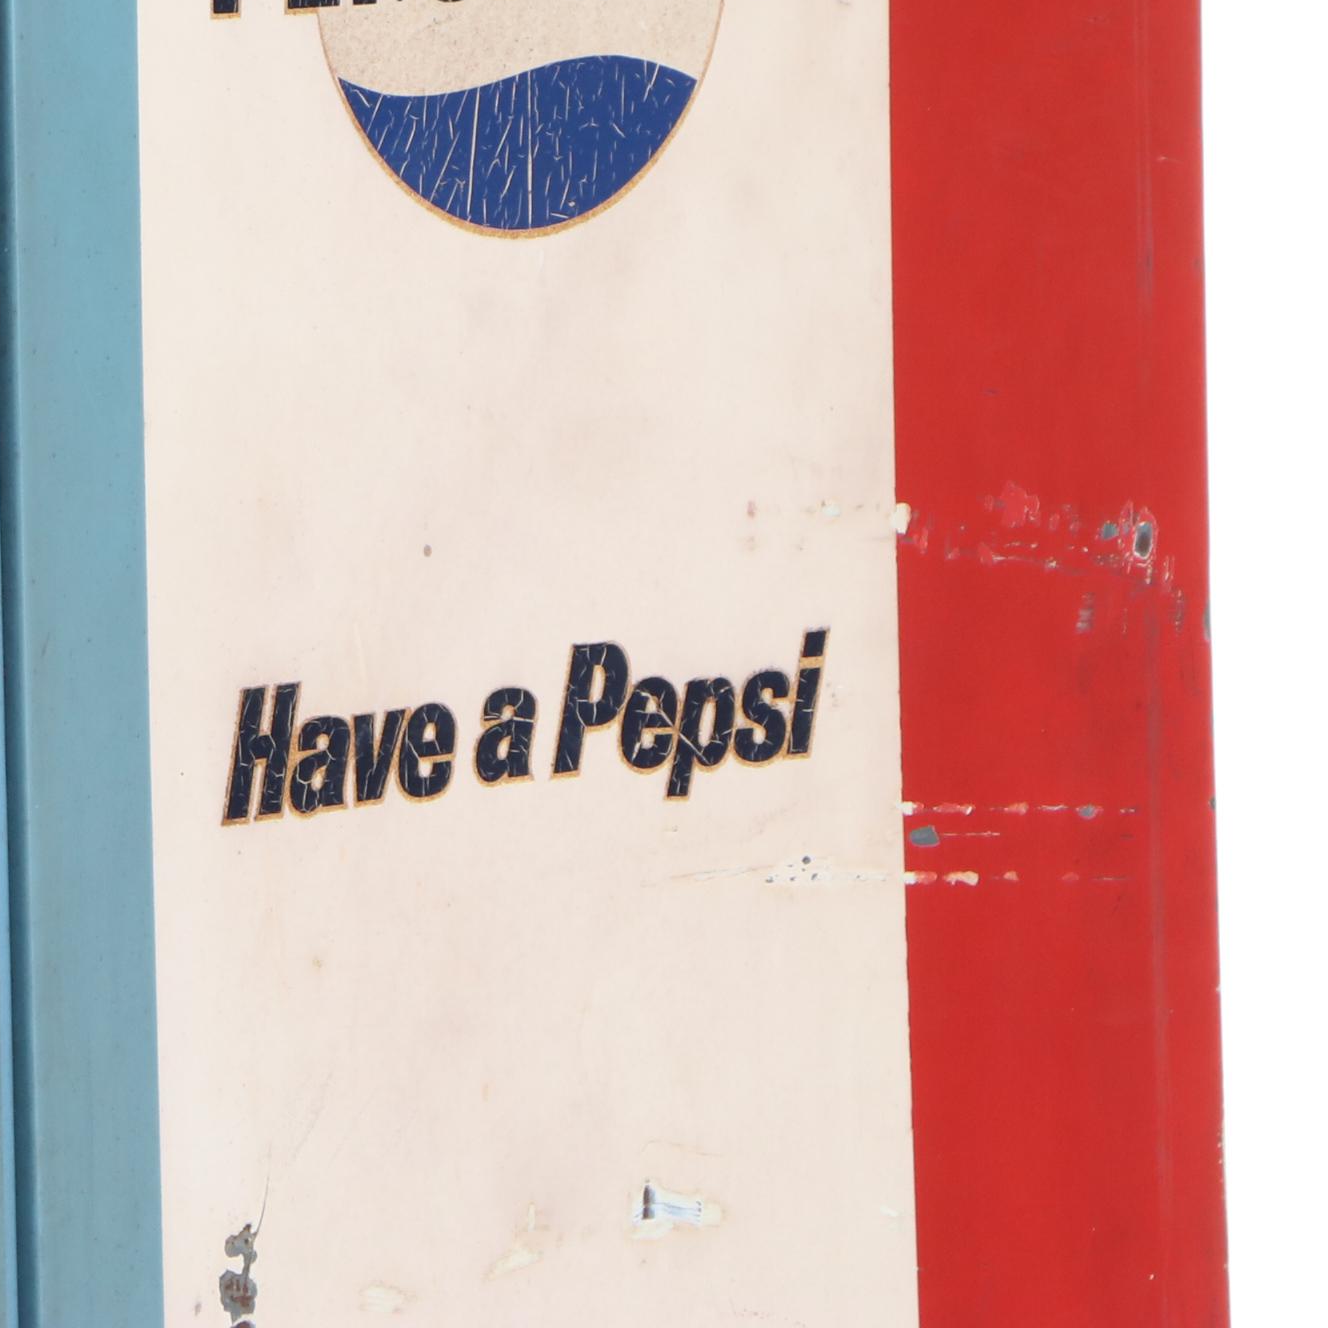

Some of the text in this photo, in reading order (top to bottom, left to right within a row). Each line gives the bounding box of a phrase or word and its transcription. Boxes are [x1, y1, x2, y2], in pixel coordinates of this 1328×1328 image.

[221, 625, 831, 827] Have a Pepsi
